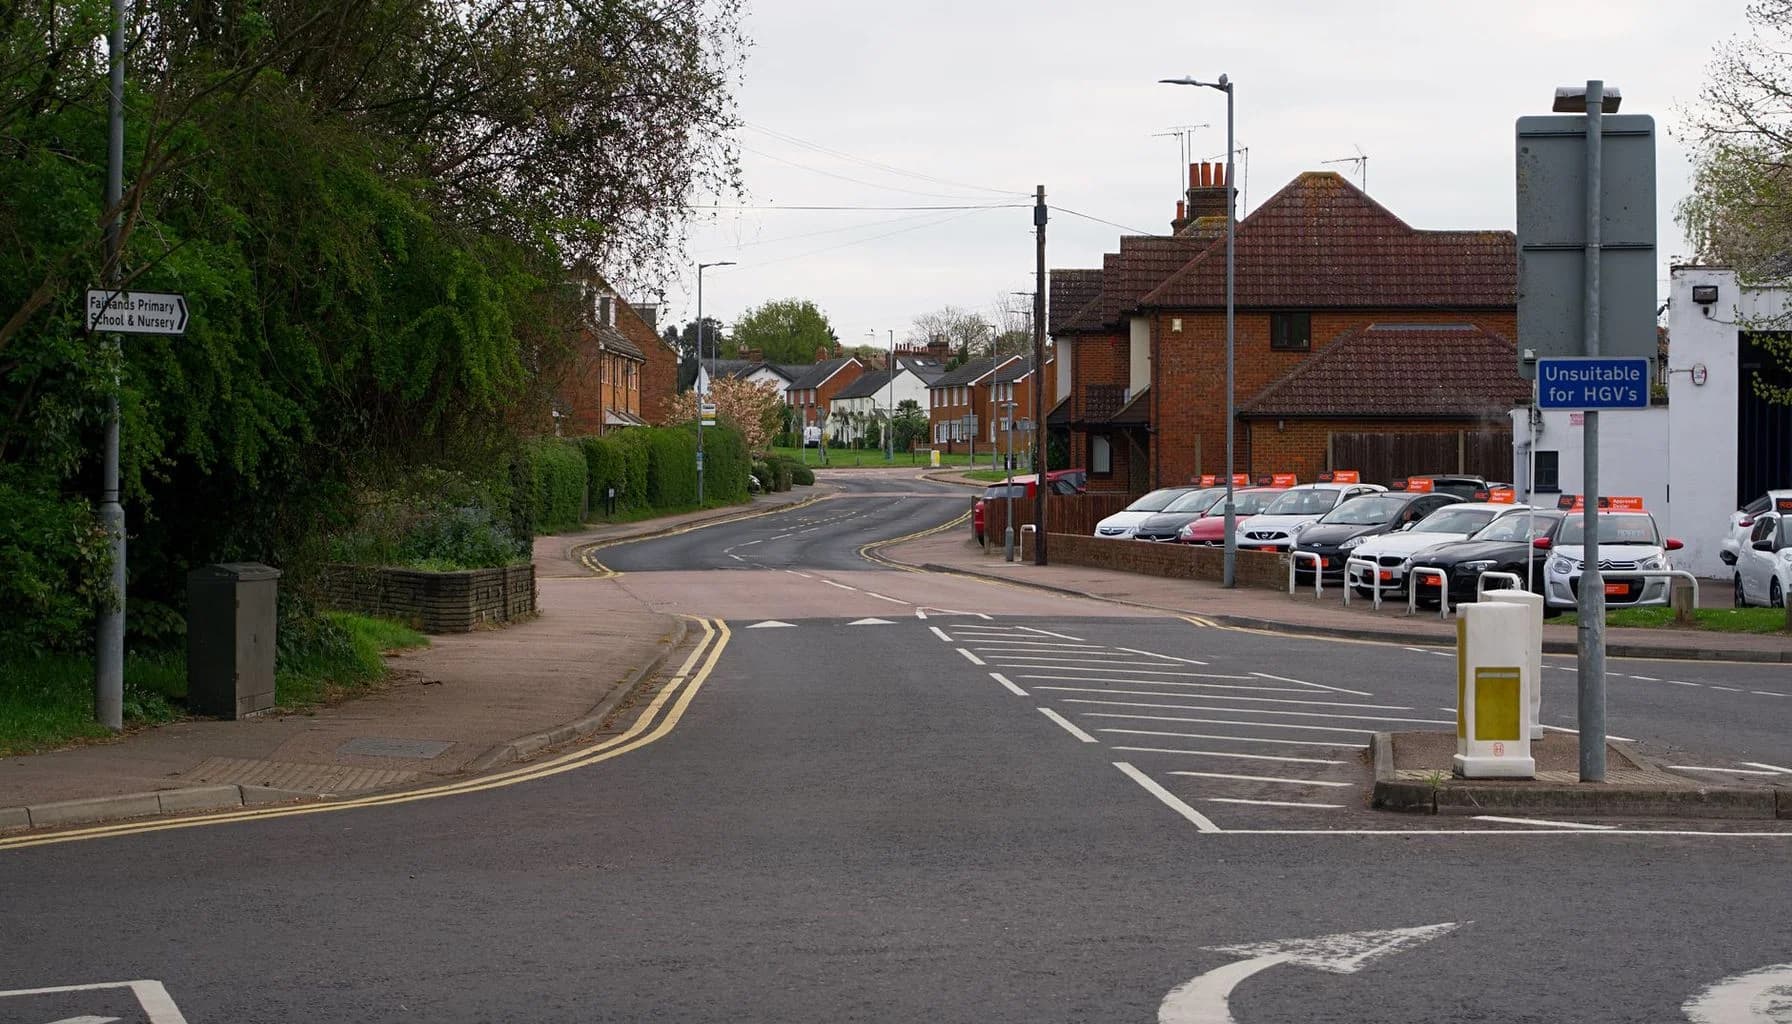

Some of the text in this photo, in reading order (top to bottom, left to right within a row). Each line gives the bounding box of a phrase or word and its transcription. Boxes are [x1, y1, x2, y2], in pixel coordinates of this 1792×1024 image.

[138, 298, 174, 315] Primary
[90, 312, 175, 330] School & Nursery
[1545, 366, 1640, 381] Unsuitable
[1549, 386, 1637, 402] for HGV's
